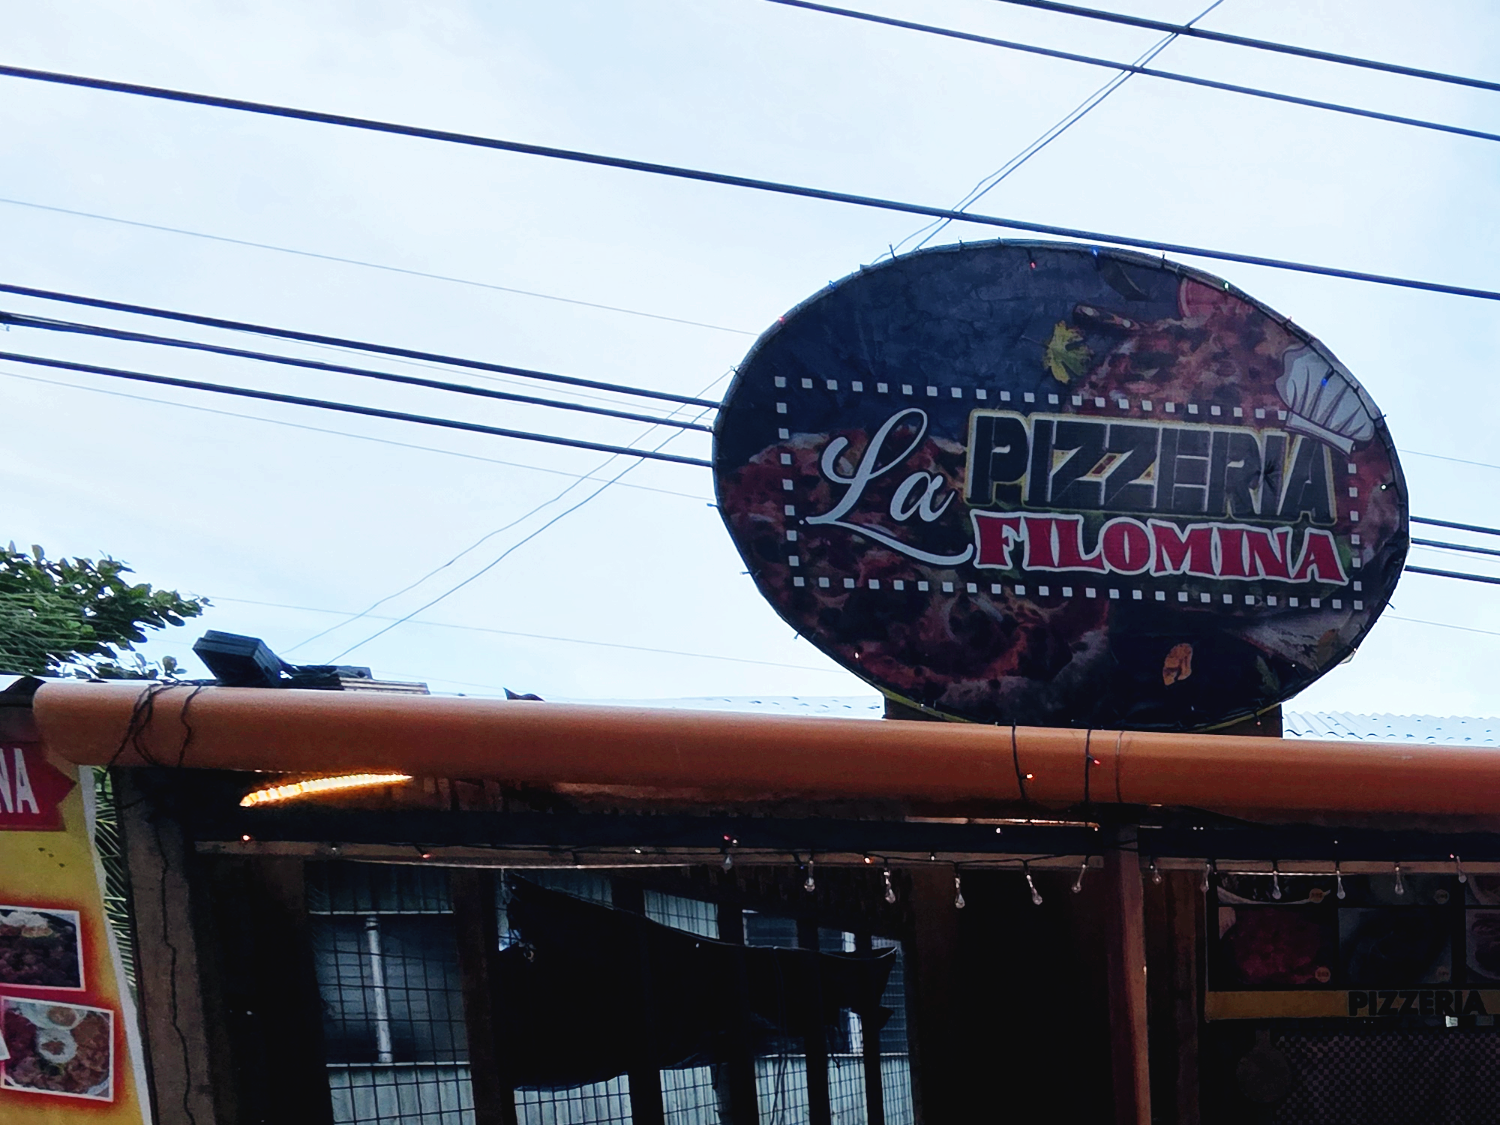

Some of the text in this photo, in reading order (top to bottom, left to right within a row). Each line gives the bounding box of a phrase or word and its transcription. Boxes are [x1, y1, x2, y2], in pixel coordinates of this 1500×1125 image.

[805, 407, 1337, 565] La PIZZERIA
[970, 509, 1350, 583] FILOMINA
[1348, 989, 1488, 1016] PIZZERIA
